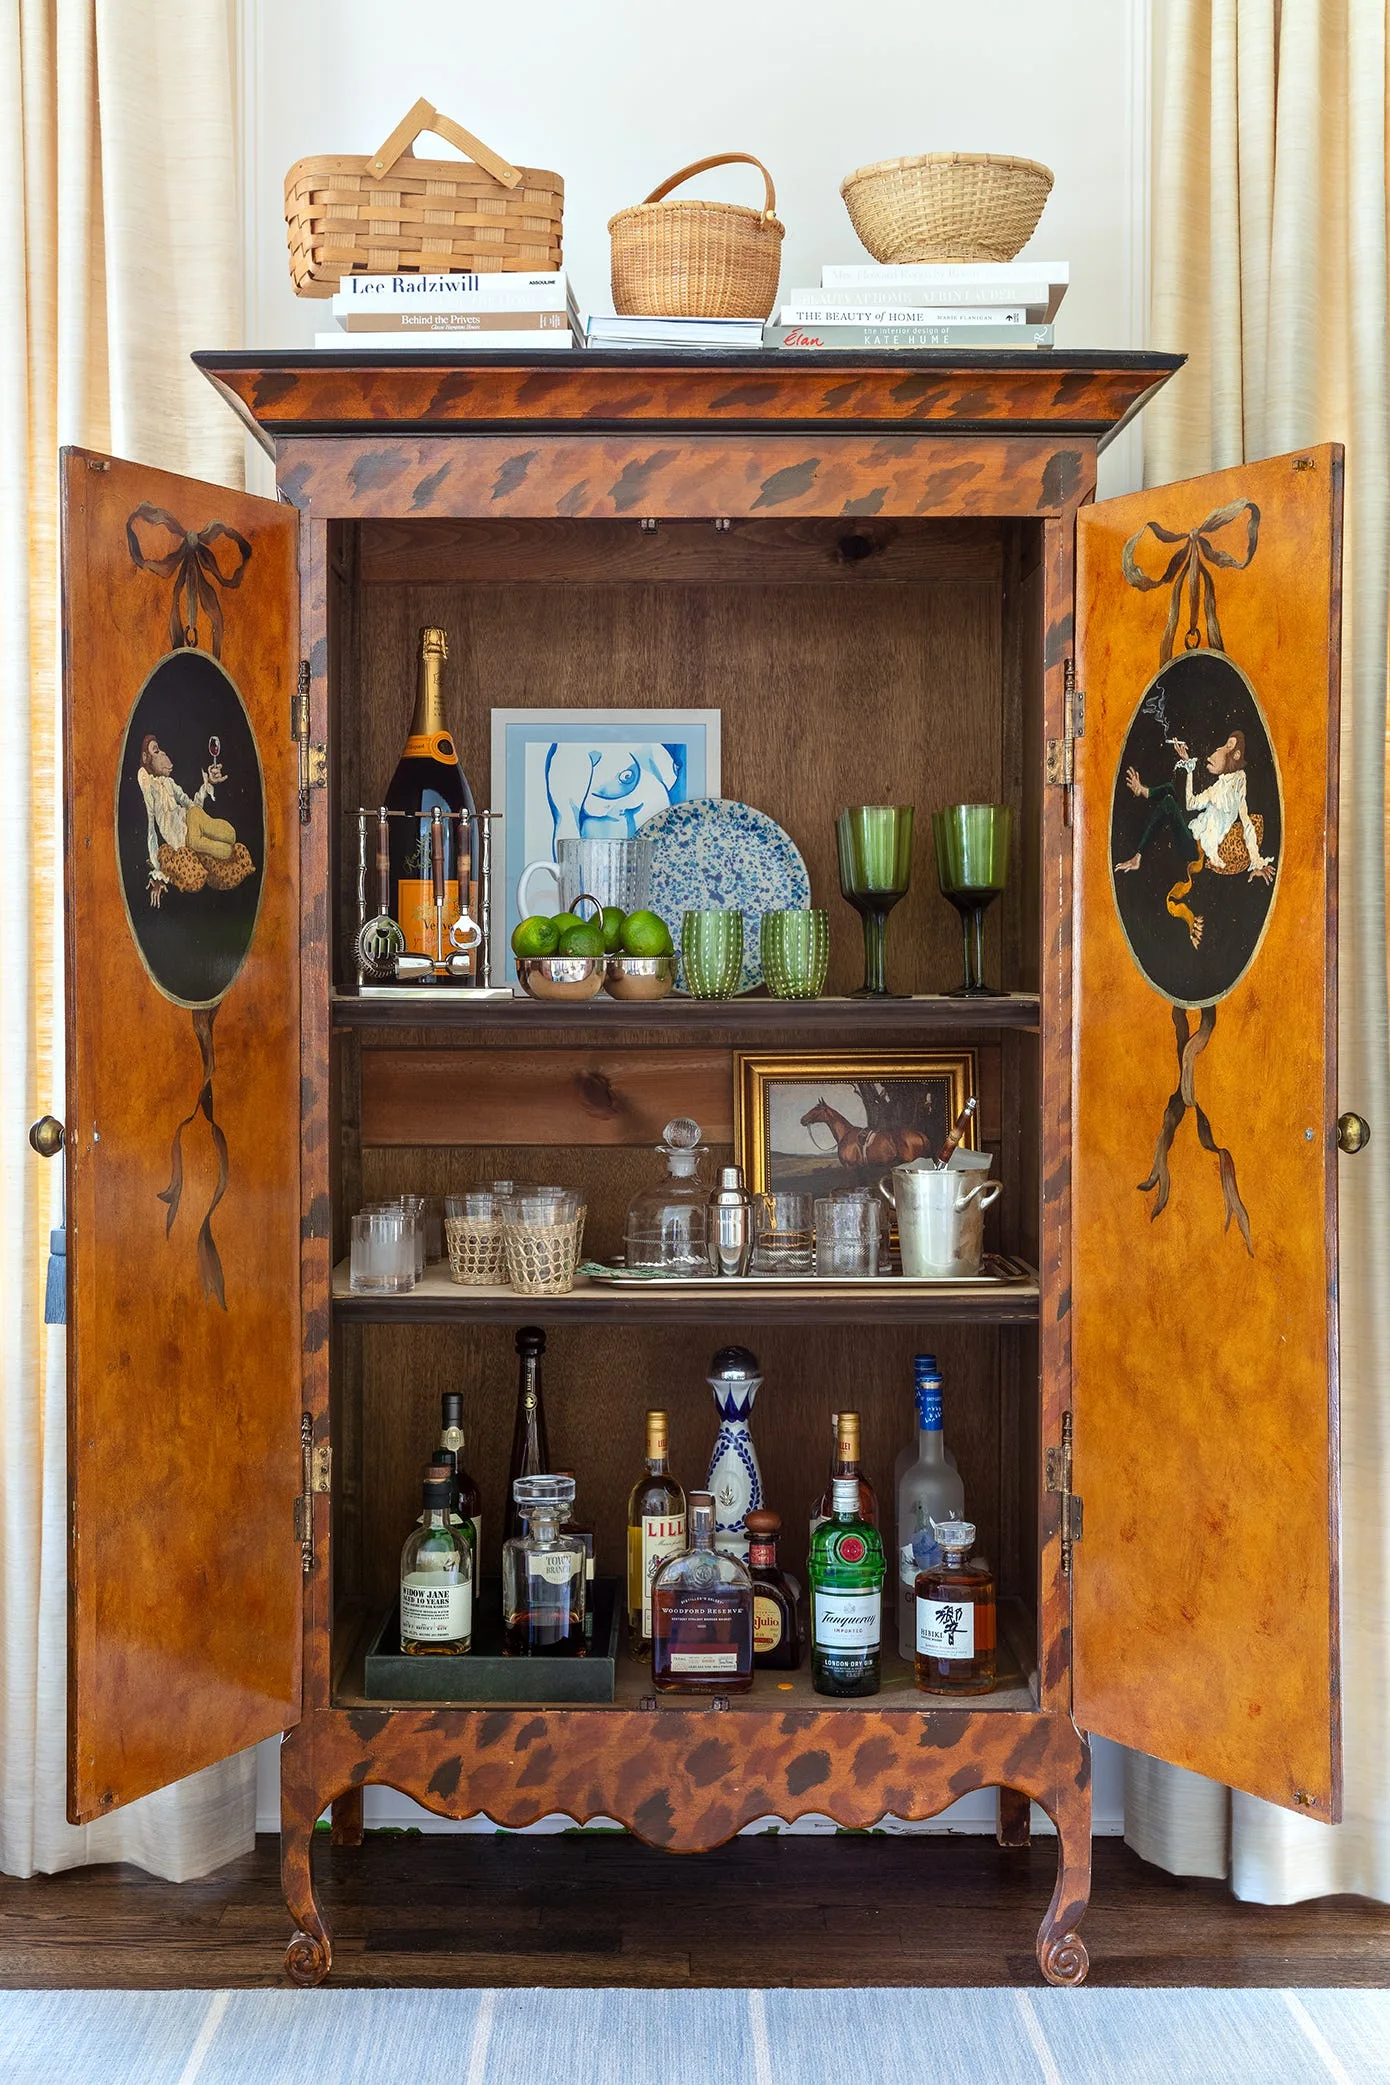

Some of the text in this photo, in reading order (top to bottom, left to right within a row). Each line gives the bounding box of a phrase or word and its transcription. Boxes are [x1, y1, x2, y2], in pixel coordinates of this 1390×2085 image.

[352, 275, 479, 294] Lee Radziwill
[401, 313, 481, 325] Behind the Privets
[796, 311, 822, 321] THE
[825, 312, 872, 321] BEAUTY
[874, 310, 886, 322] of
[888, 312, 924, 322] HOME
[783, 327, 825, 347] Élan
[912, 328, 939, 337] design
[941, 327, 950, 335] of
[864, 335, 950, 345] KATE HUME
[424, 918, 454, 931] Veve
[647, 1520, 686, 1537] LILL
[402, 1587, 450, 1599] WIDOW JANE
[416, 1597, 426, 1605] 10
[661, 1607, 744, 1615] WOODFORD RESERVE
[821, 1610, 877, 1628] Tanqueray
[920, 1628, 943, 1639] HIBIKI
[824, 1659, 849, 1668] LONDON
